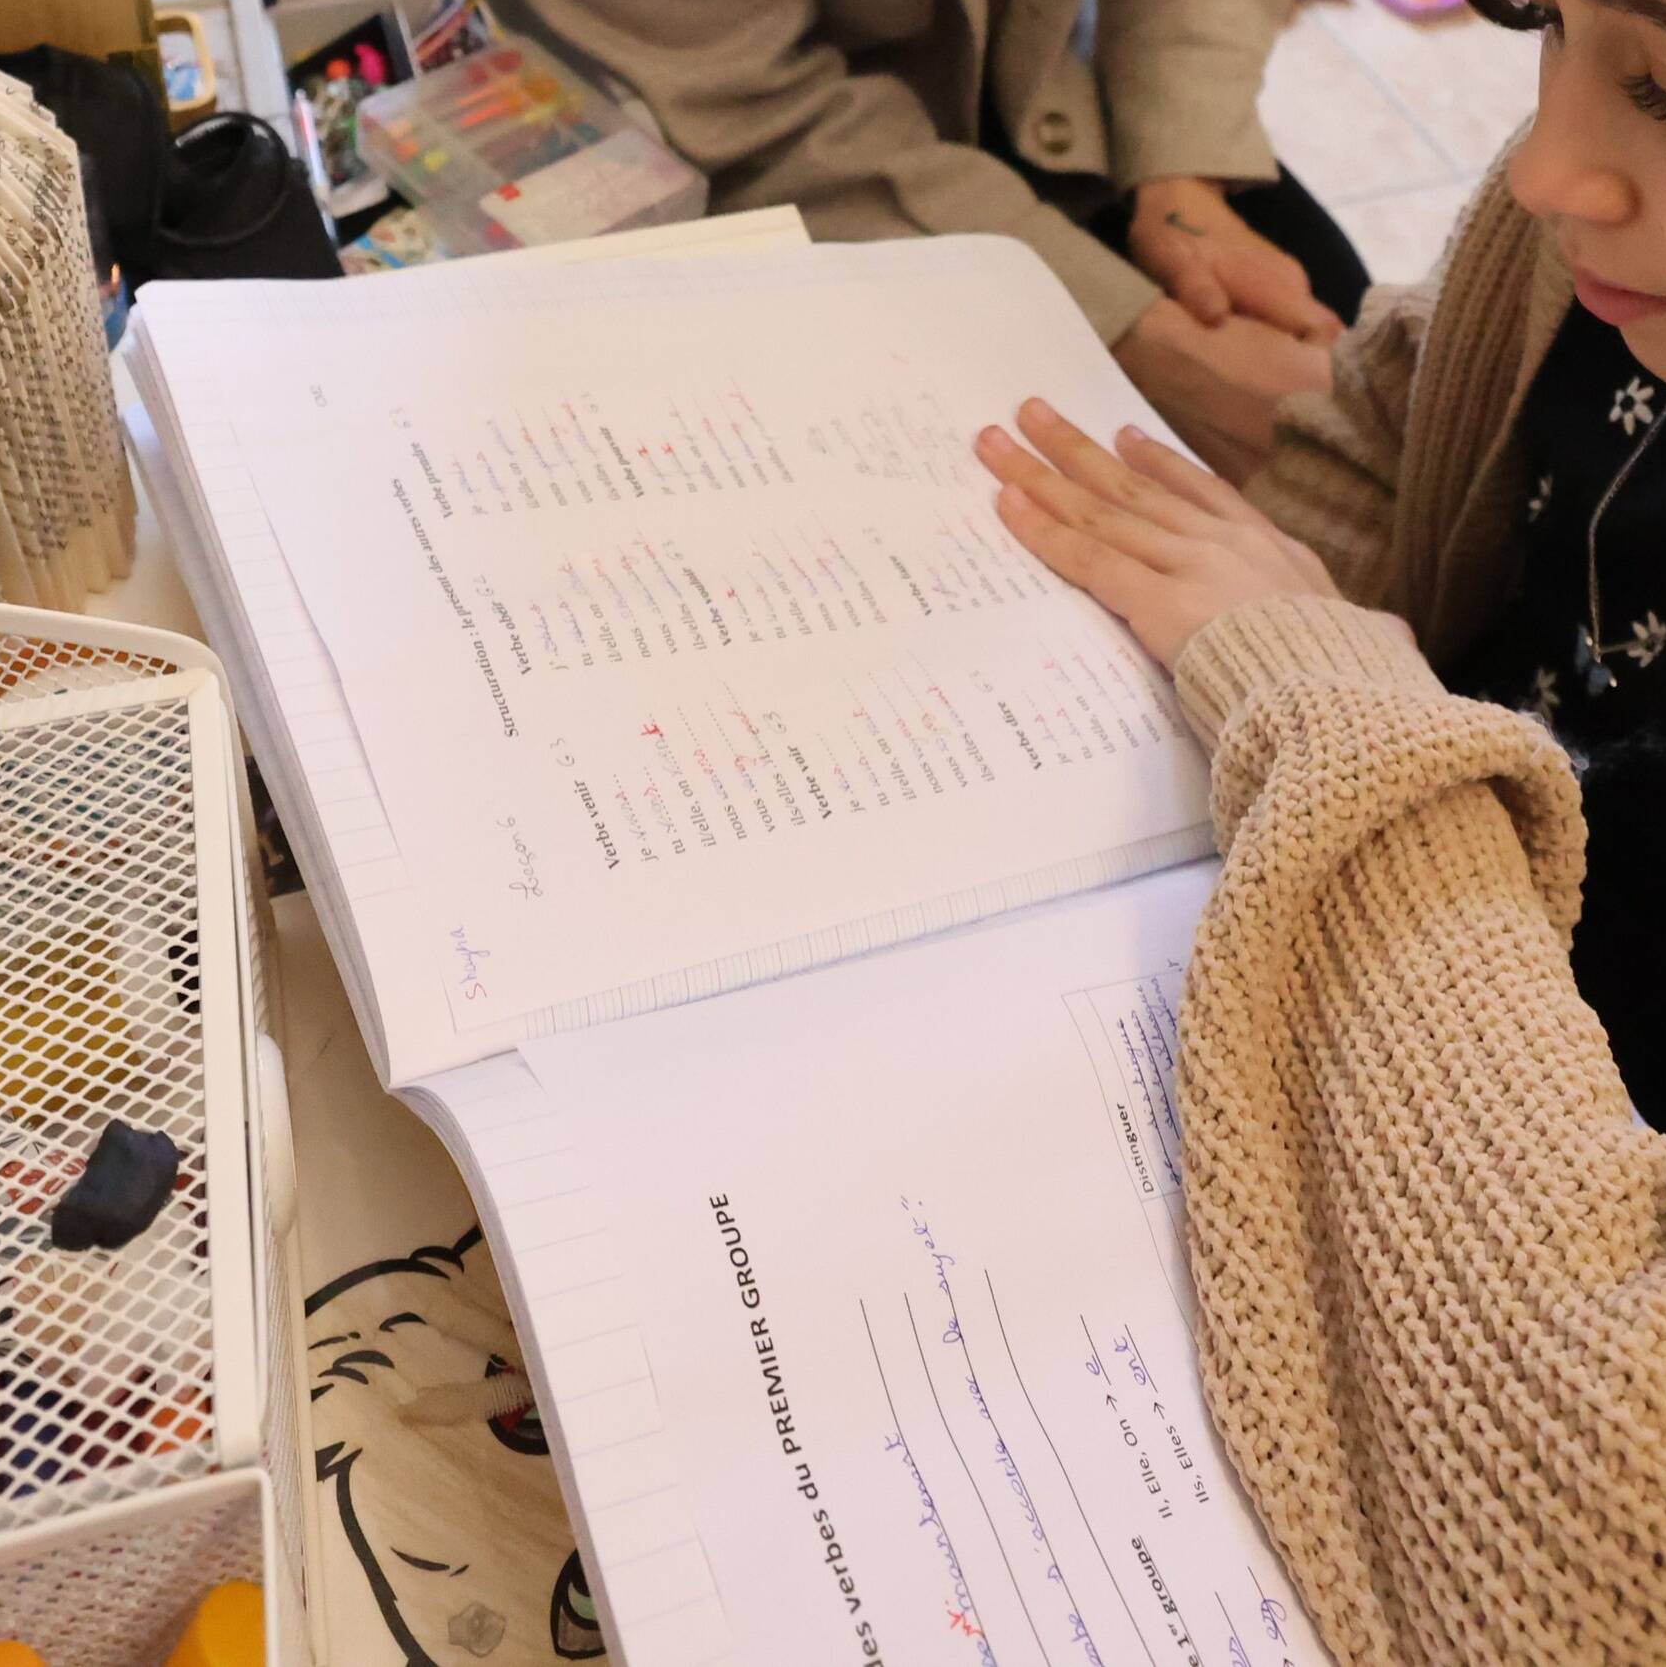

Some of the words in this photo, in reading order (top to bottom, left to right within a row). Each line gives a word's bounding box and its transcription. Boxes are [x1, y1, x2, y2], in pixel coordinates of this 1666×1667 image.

[391, 478, 414, 515] verbes
[623, 467, 645, 498] Verbe
[432, 486, 454, 519] Verbe
[411, 516, 433, 552] autres
[427, 554, 444, 574] des
[588, 603, 604, 619] on
[842, 599, 862, 628] vous
[908, 581, 933, 617] Verbe
[461, 618, 476, 630] le
[598, 621, 623, 663] il/elle,
[660, 622, 678, 655] vous
[679, 602, 708, 651] ils/elles
[709, 607, 732, 647] Verbe
[748, 630, 764, 643] je
[510, 633, 532, 676] Verbe
[581, 652, 594, 667] tu
[630, 626, 652, 659] nous
[473, 640, 520, 738] Structuration
[997, 701, 1019, 727] dire
[787, 745, 809, 773] voir
[876, 737, 892, 755] on
[962, 731, 996, 783] ils/elles
[1015, 730, 1043, 771] Verbe
[1056, 752, 1073, 765] je
[678, 779, 694, 798] on
[889, 756, 918, 801] il/elle,
[919, 761, 944, 794] nous
[948, 755, 969, 788] vous
[574, 780, 599, 819] venir
[753, 797, 776, 833] vous
[772, 772, 806, 827] ils/elles
[805, 775, 833, 820] Verbe
[849, 799, 866, 813] je
[876, 791, 891, 807] tu
[689, 800, 717, 847] il/elle,
[723, 804, 748, 840] nous
[594, 822, 620, 870] Verbe
[640, 847, 660, 862] je
[671, 838, 686, 855] tu
[1116, 1103, 1155, 1194] Distinguer
[709, 1193, 761, 1309] GROUPE
[750, 1317, 802, 1455] PREMIER
[1119, 1418, 1138, 1447] On
[1166, 1425, 1194, 1470] Elles
[795, 1462, 819, 1500] du
[1139, 1451, 1162, 1495] Elle,
[1193, 1474, 1210, 1504] Ils,
[1157, 1499, 1173, 1519] Il,
[812, 1508, 862, 1615] verbes
[1131, 1535, 1180, 1615] groupe
